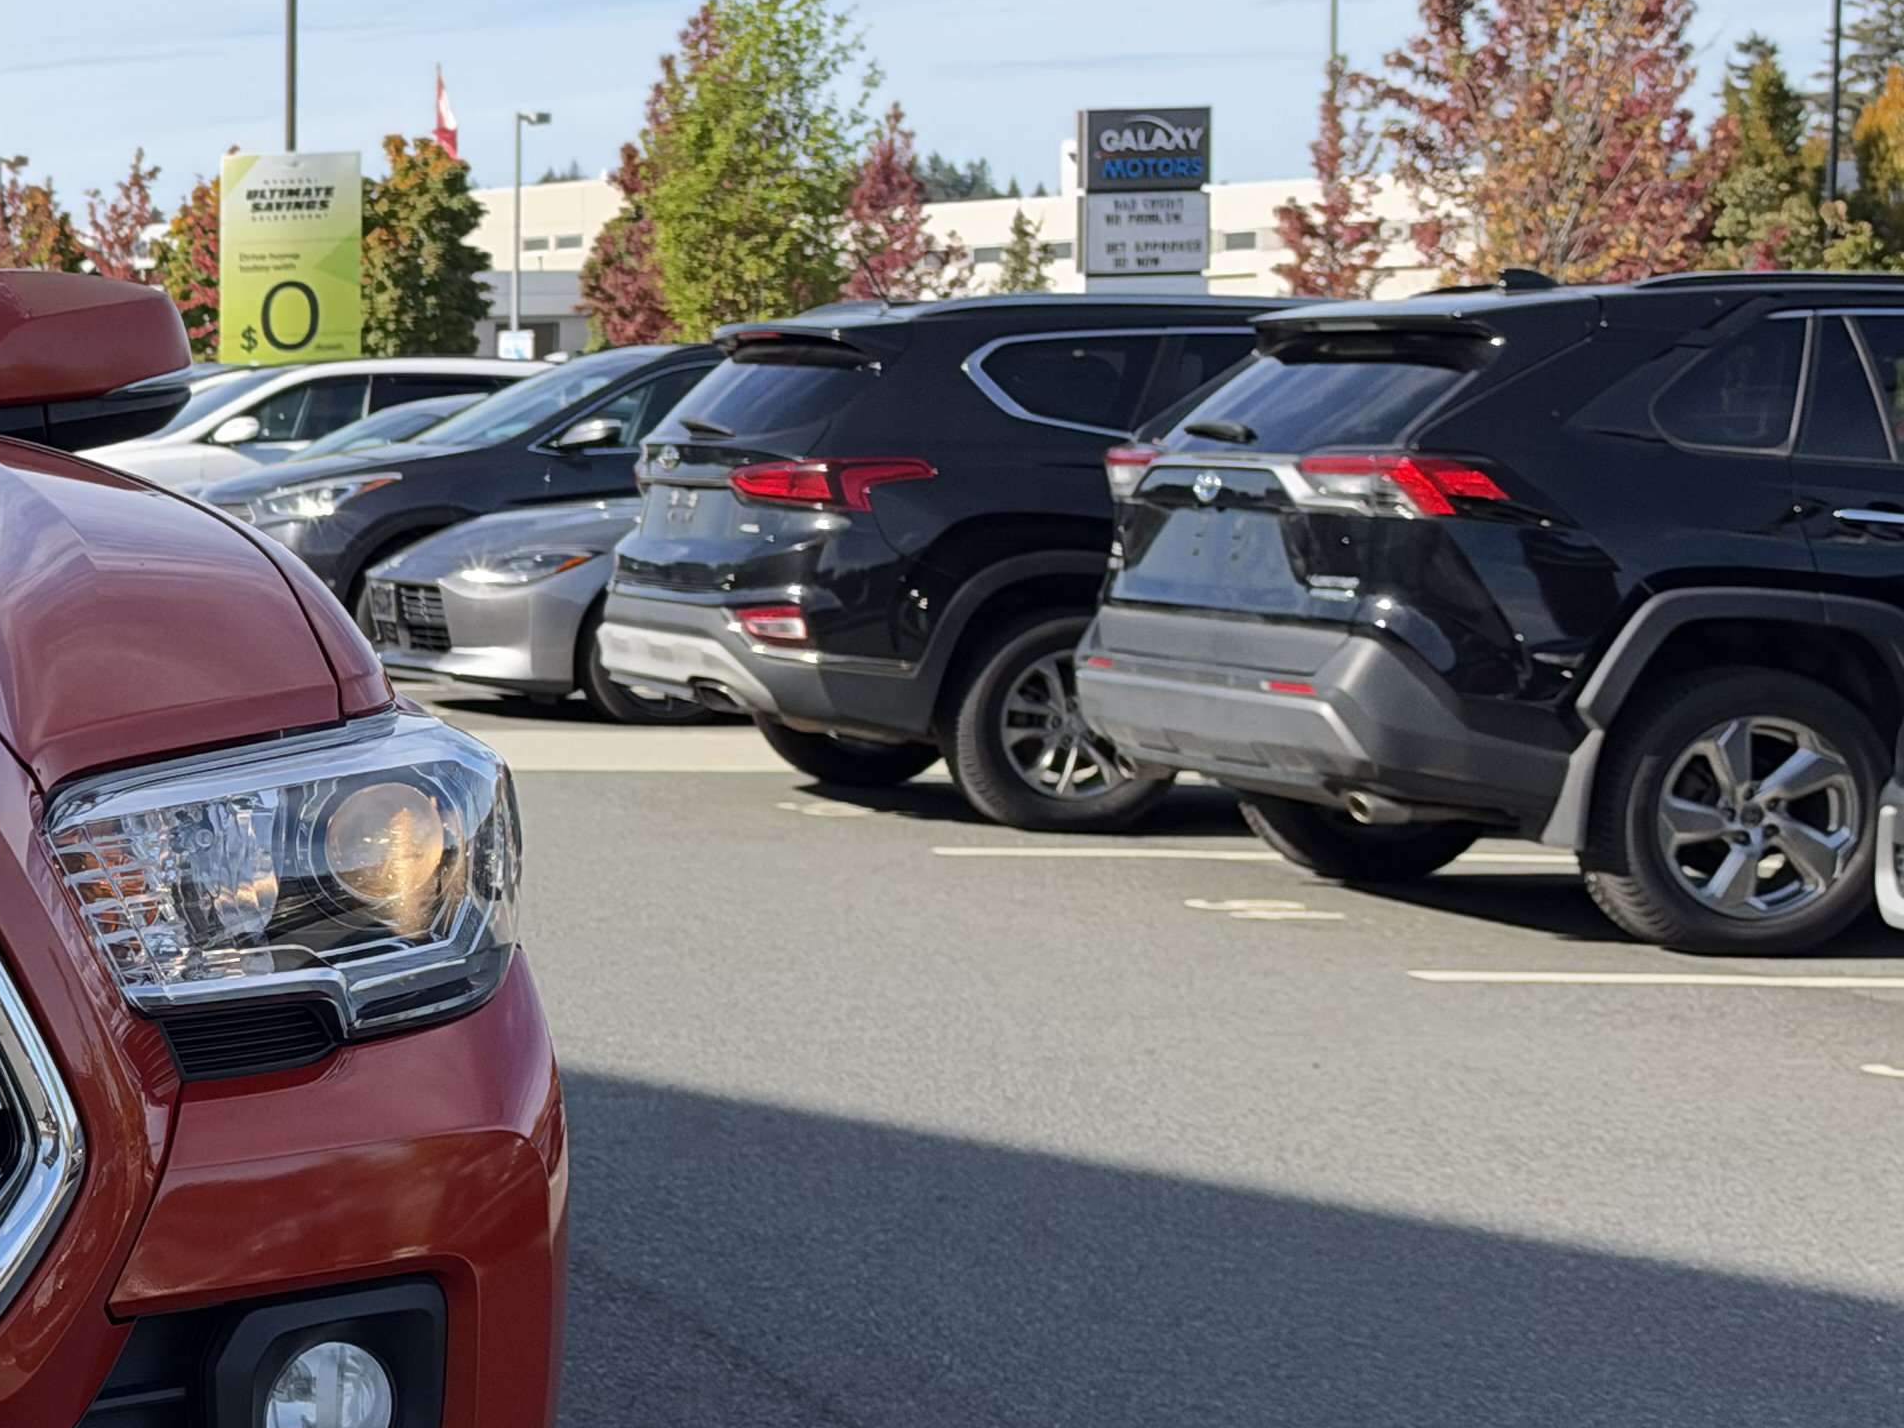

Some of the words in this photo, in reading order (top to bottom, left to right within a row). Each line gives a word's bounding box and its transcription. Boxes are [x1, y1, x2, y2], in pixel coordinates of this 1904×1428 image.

[1099, 127, 1204, 152] GALAXY
[1101, 156, 1202, 179] MOTORS
[246, 186, 335, 200] ULTIMATE
[250, 200, 330, 213] SAVINGS
